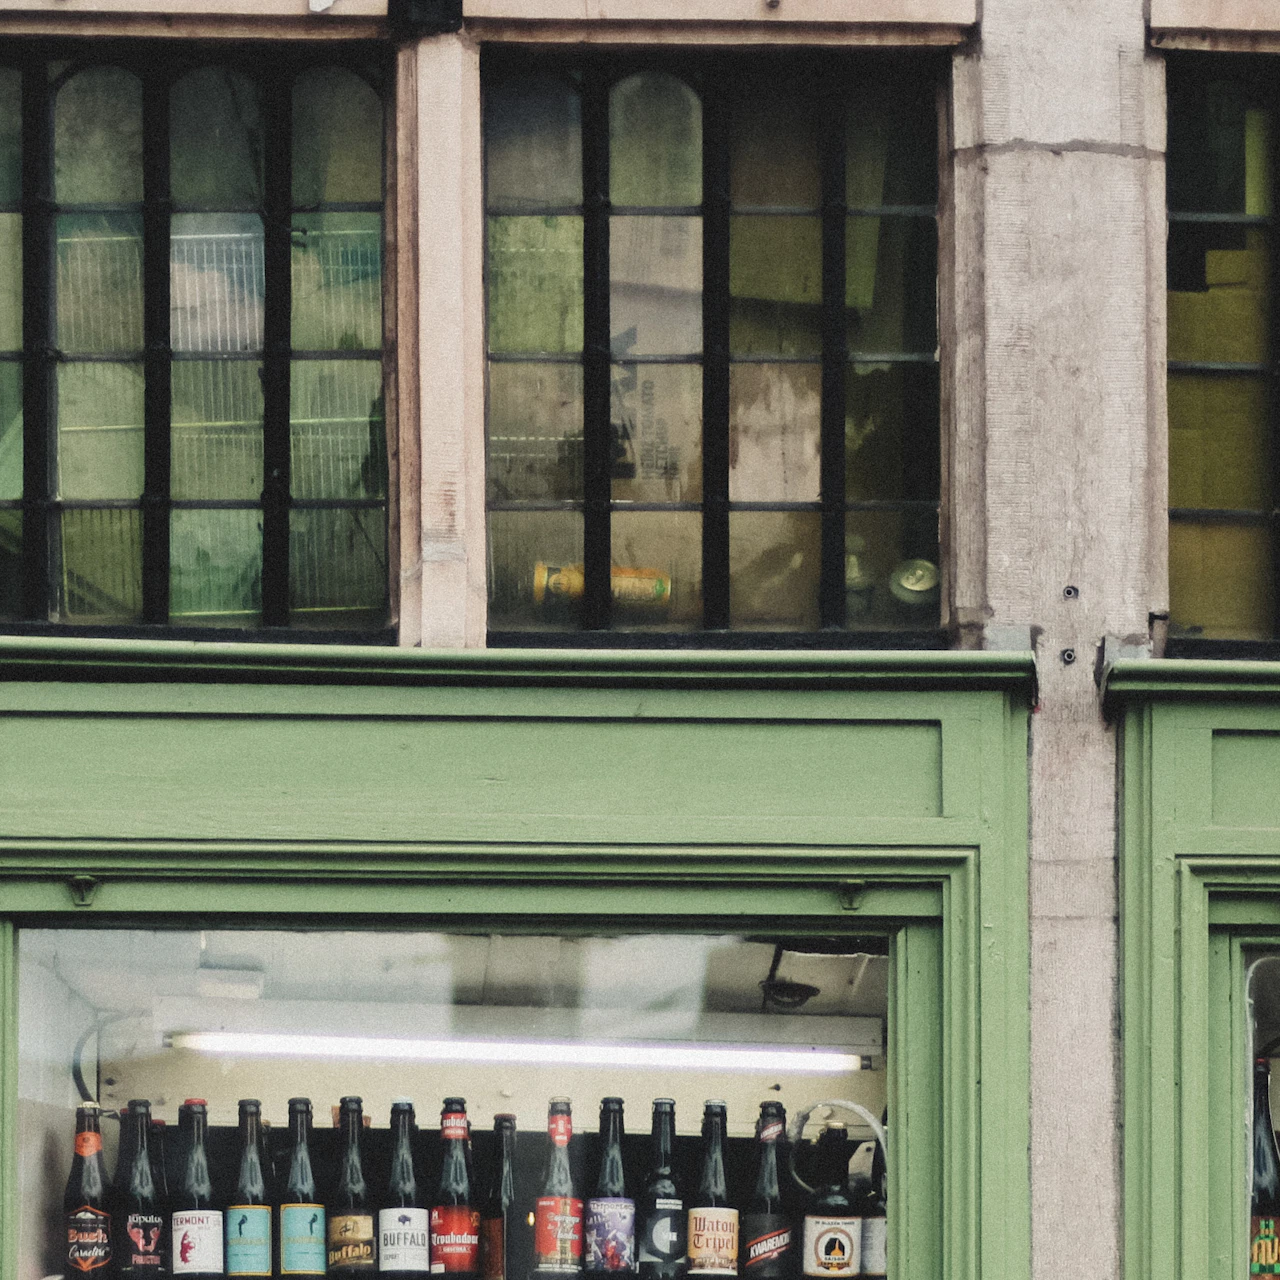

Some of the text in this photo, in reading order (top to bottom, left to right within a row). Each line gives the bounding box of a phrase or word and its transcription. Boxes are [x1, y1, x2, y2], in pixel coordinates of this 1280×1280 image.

[693, 1216, 735, 1232] Watou
[67, 1229, 108, 1243] Bush
[383, 1233, 426, 1247] BUFFALO
[693, 1234, 735, 1250] Tripel
[328, 1243, 371, 1264] Buffalo
